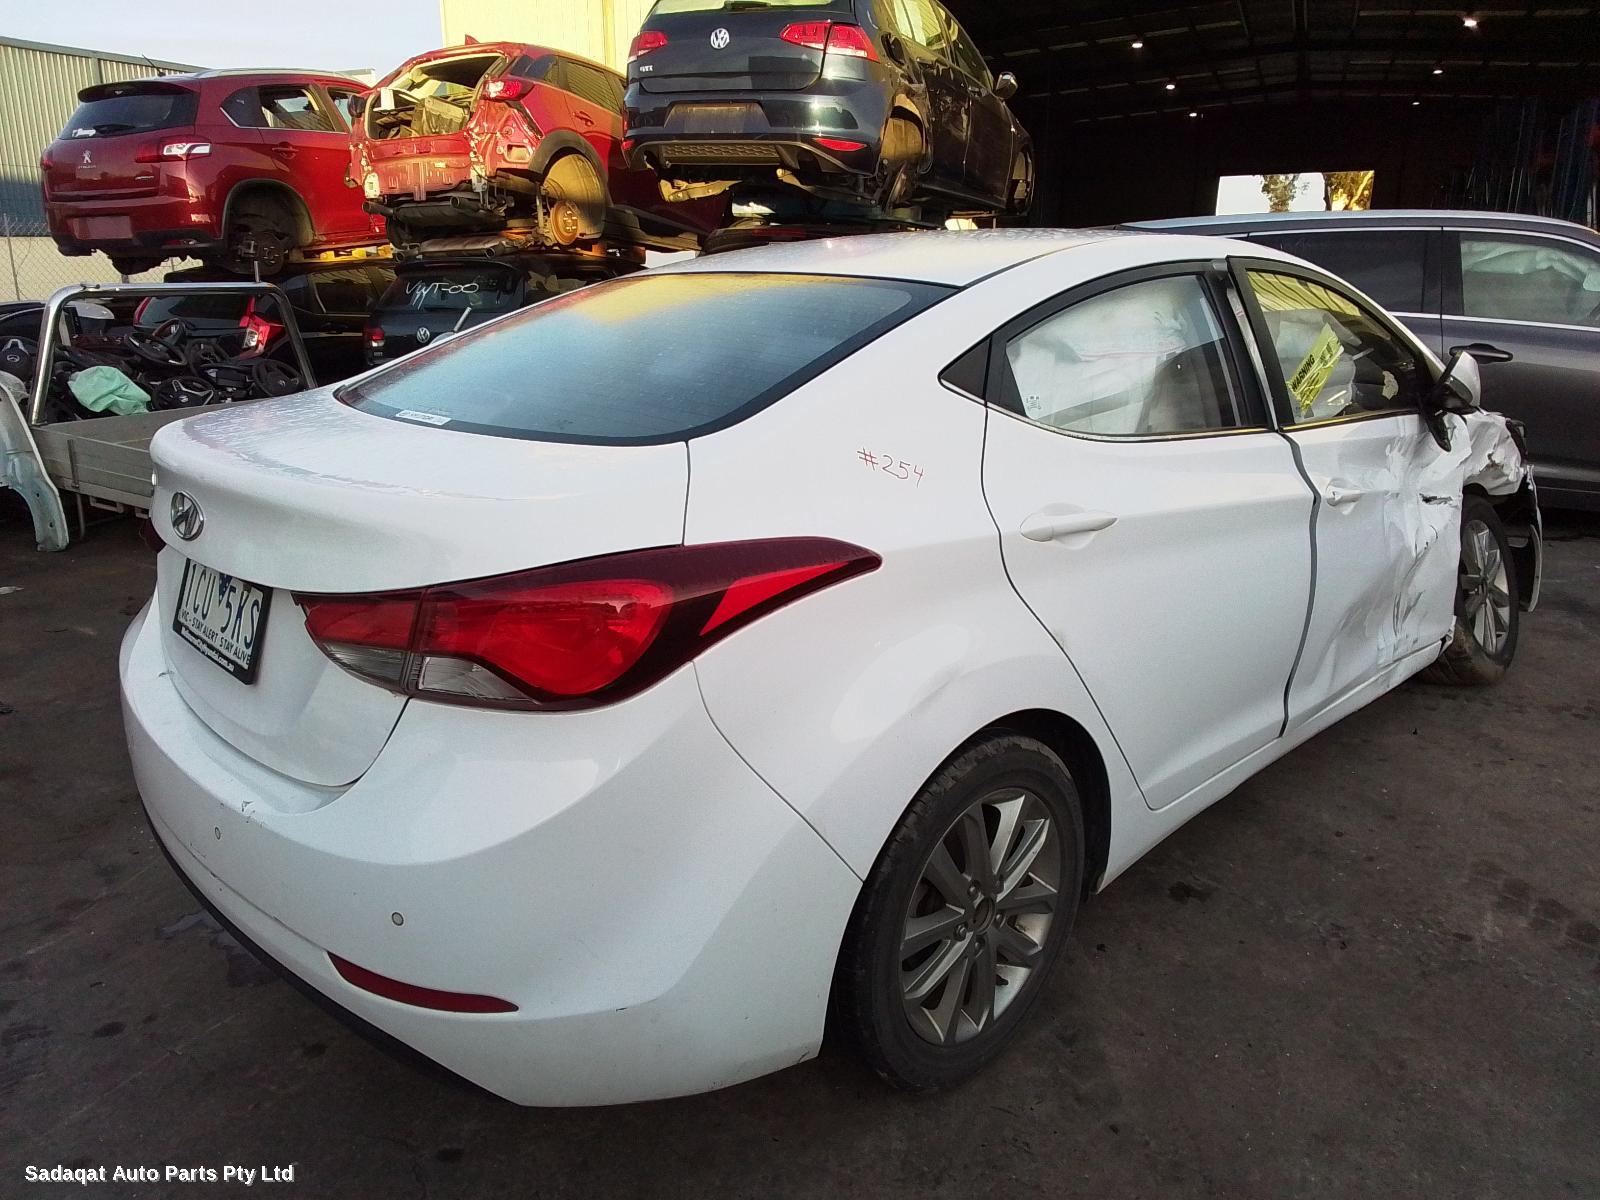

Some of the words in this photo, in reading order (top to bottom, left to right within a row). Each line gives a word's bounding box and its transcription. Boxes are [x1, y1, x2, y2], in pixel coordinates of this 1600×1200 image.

[1291, 354, 1316, 392] WARNING
[857, 447, 924, 488] #254
[221, 584, 260, 650] 5KS
[191, 617, 205, 633] STAY
[202, 625, 219, 643] ALERT
[219, 636, 235, 653] STAY
[233, 646, 251, 665] ALIVE
